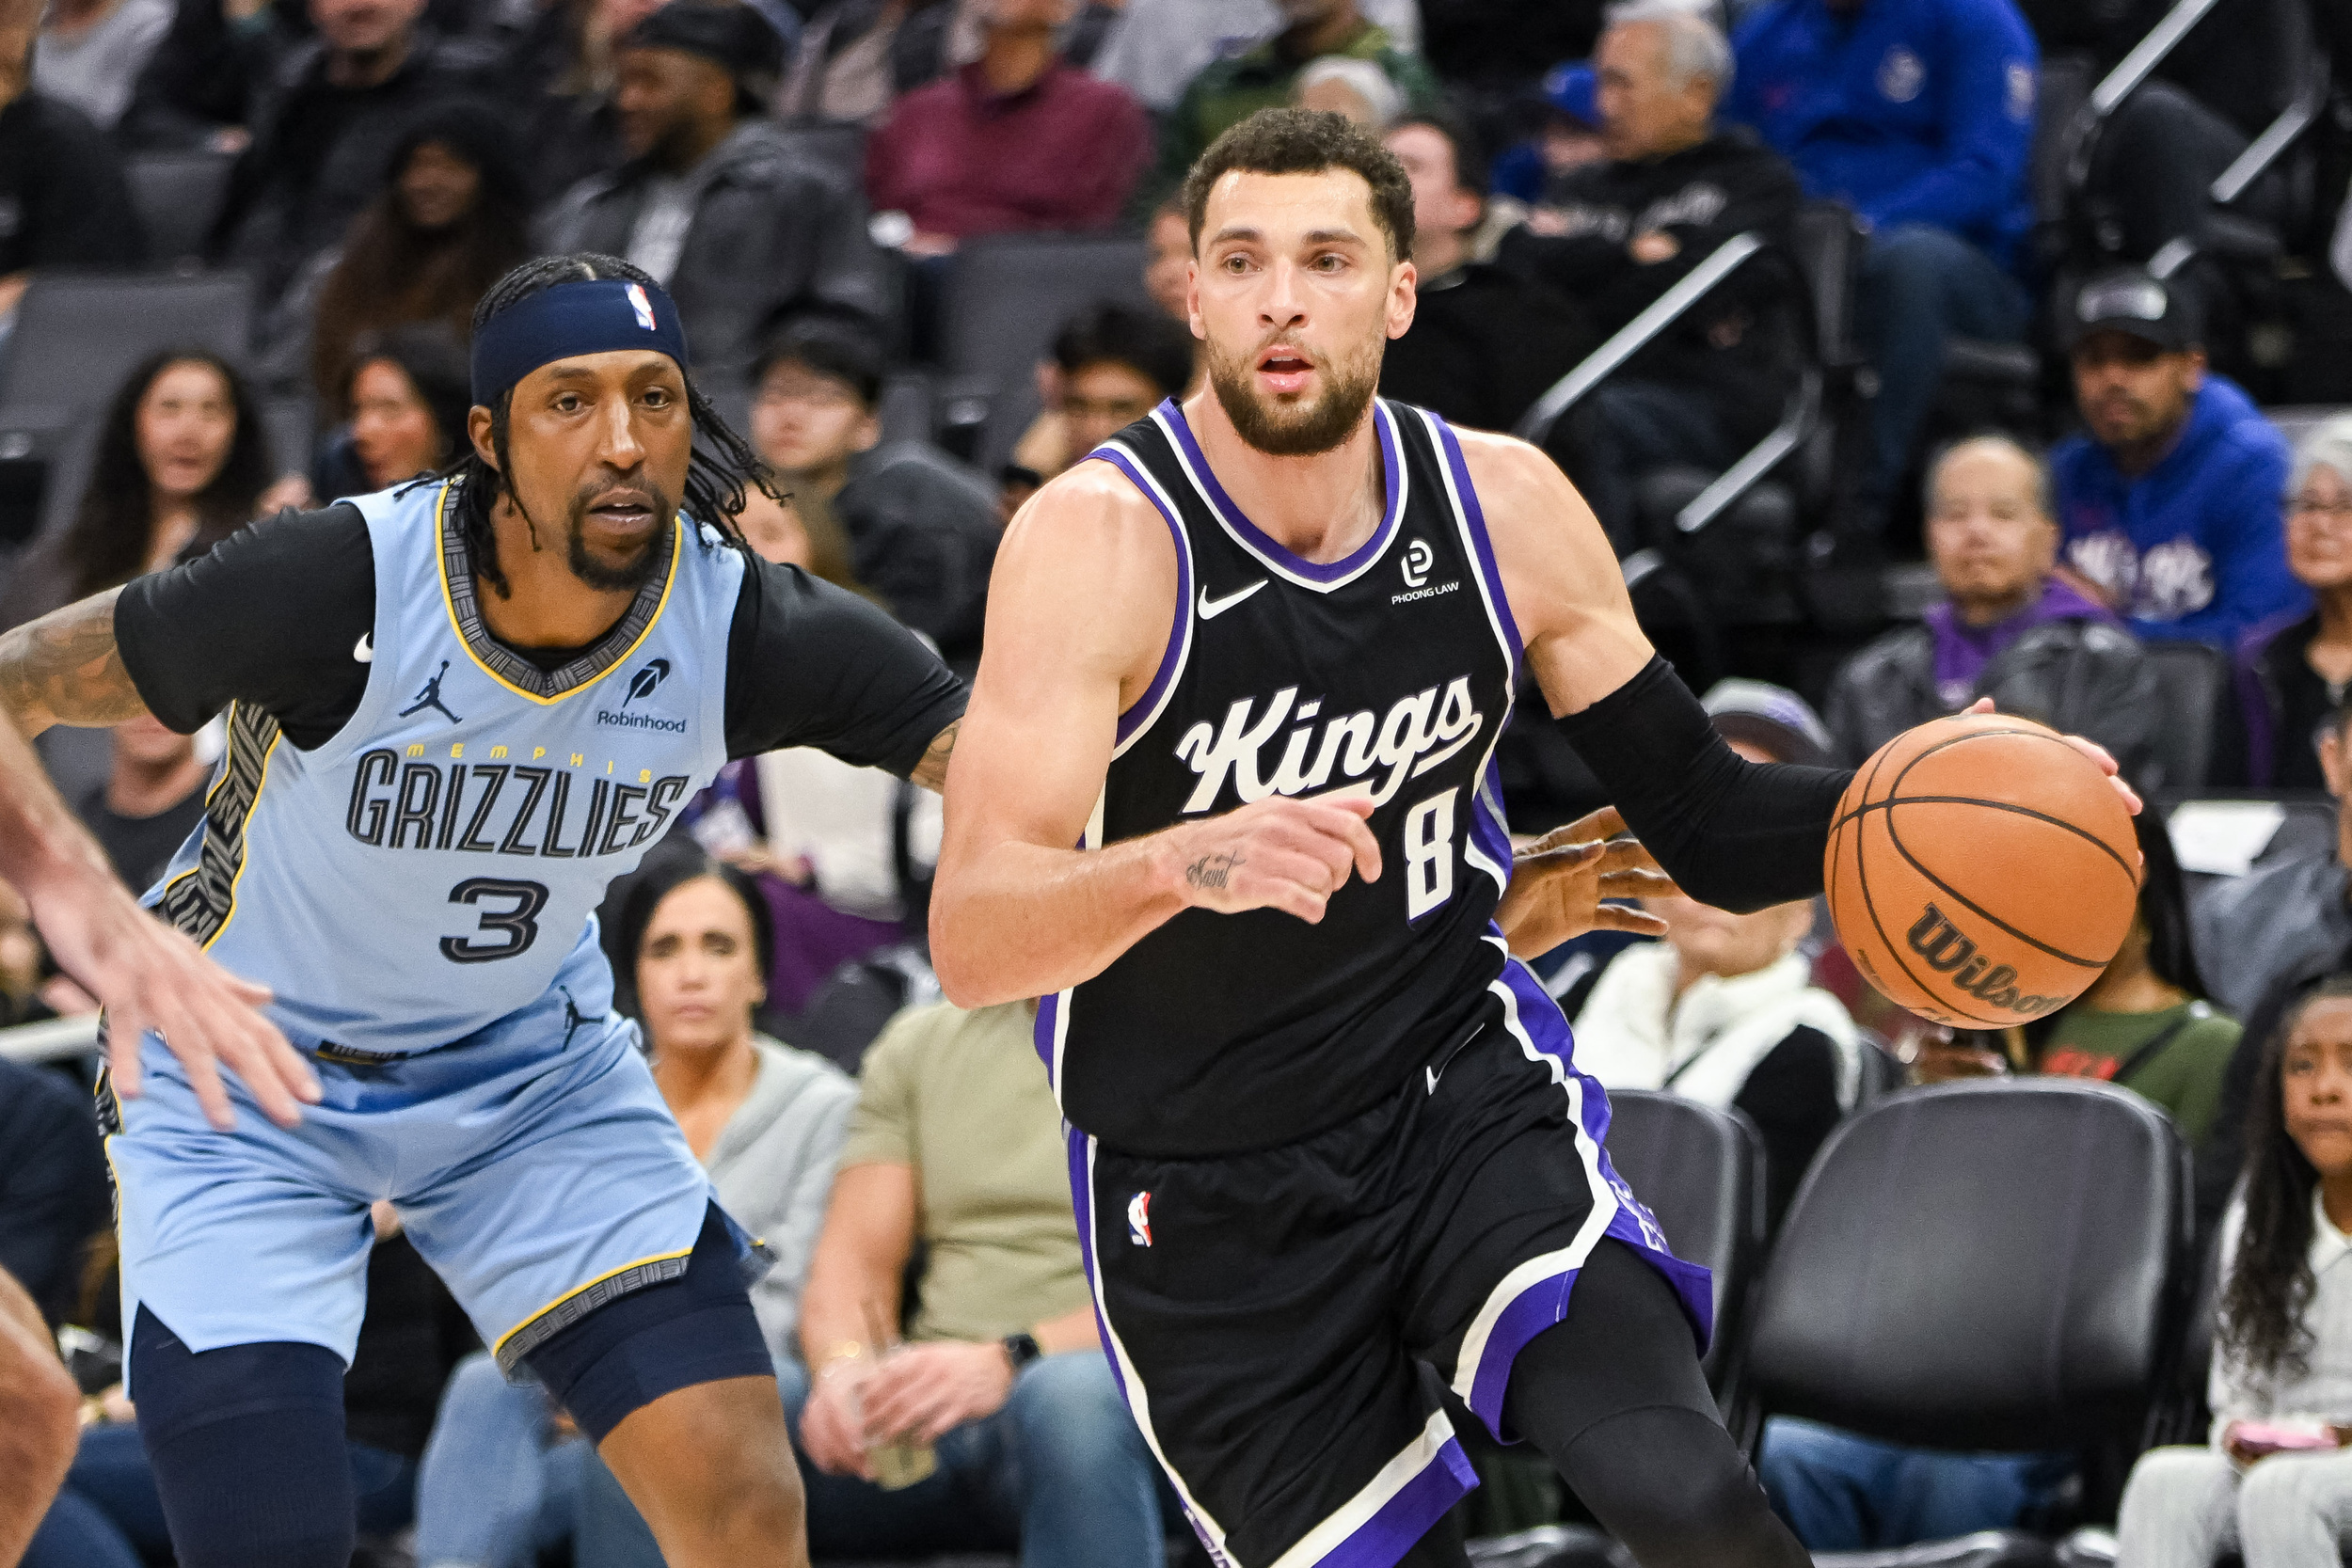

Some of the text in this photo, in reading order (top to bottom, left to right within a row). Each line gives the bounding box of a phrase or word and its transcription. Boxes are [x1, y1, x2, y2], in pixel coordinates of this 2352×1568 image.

[1391, 581, 1459, 605] PHOONG LAW
[406, 743, 652, 784] MEMPHIS
[596, 709, 687, 734] Robinhood
[1174, 673, 1484, 816] Kings
[345, 748, 691, 859] GRIZZLIES
[1404, 786, 1461, 927] 8
[438, 877, 549, 965] 3
